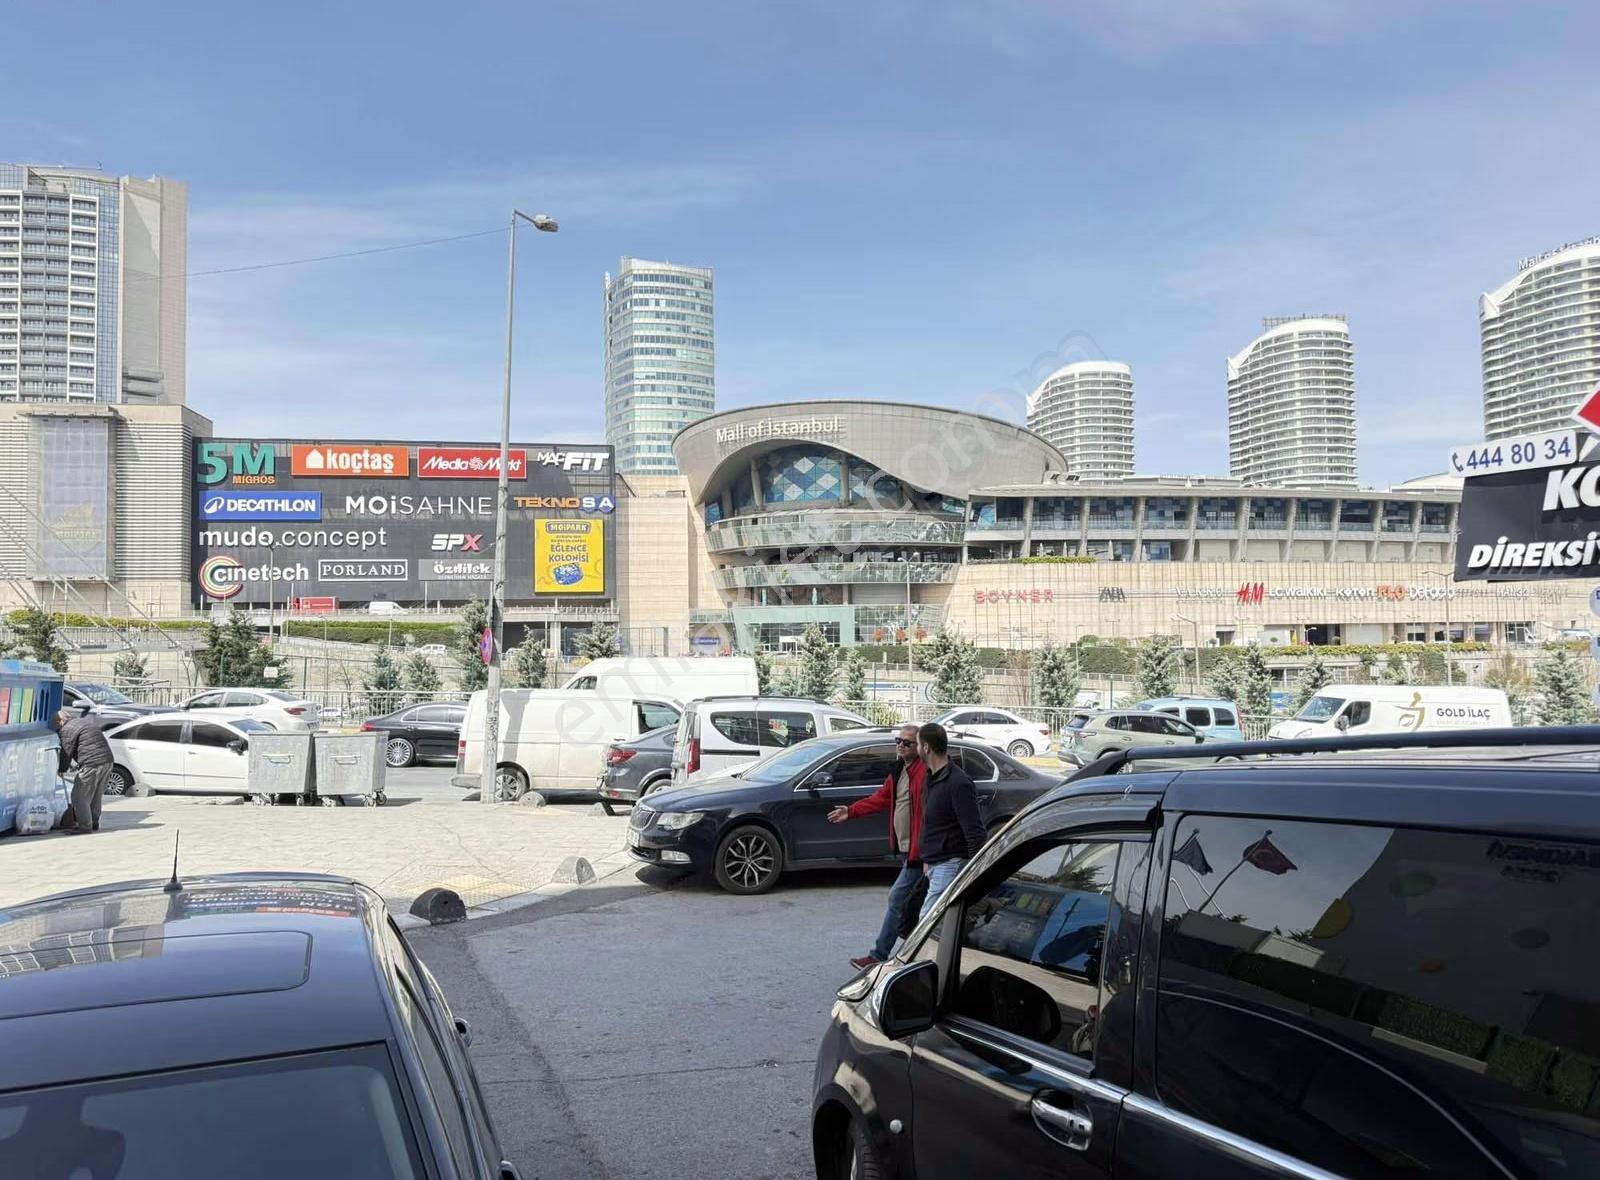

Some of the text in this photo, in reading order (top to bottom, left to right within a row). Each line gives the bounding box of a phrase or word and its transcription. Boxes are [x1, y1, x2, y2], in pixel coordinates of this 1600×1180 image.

[716, 423, 744, 441] Mall
[748, 420, 765, 437] of
[326, 448, 394, 473] koçtaş
[1466, 436, 1571, 470] 444 80 34
[197, 442, 275, 484] 5M
[422, 455, 522, 472] Media Mrkt
[232, 475, 276, 485] MIGROS
[226, 499, 316, 512] DECATHLON
[513, 496, 614, 509] TEKNOSA
[199, 527, 387, 550] mudo.concept
[431, 534, 483, 552] SPX
[550, 542, 587, 552] EĞLENCE
[1467, 531, 1600, 568] DİREKSİ
[322, 564, 405, 576] PORLAND
[433, 561, 491, 574] Özdilek
[976, 589, 1054, 603] BOYNER
[1436, 706, 1491, 721] GOLD İLAÇ
